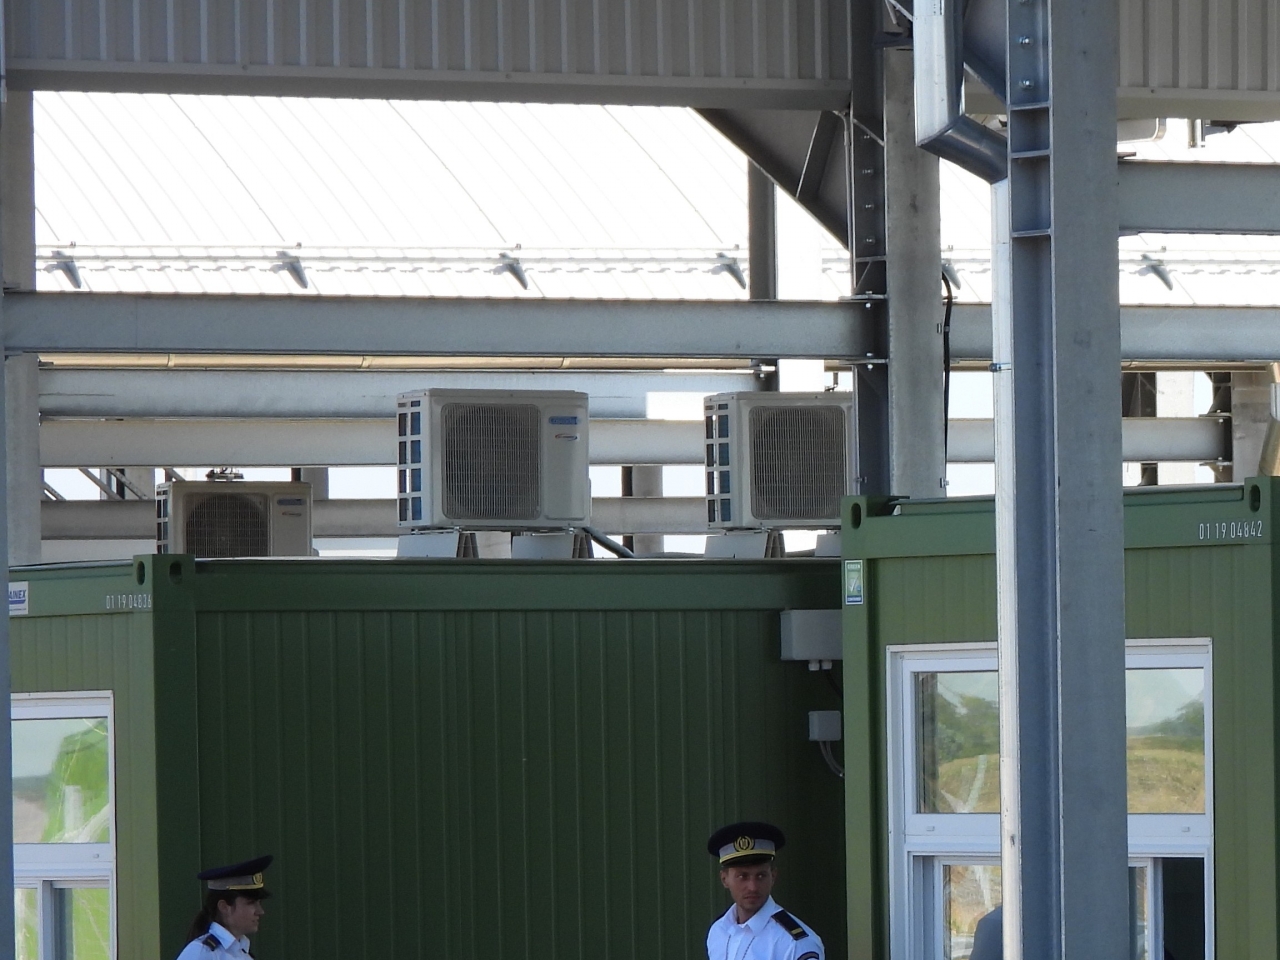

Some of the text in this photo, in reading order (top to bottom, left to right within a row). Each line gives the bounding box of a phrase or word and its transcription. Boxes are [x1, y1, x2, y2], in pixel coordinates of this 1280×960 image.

[1199, 520, 1263, 540] 01 19 04842
[106, 595, 115, 609] 01
[118, 594, 126, 608] 19
